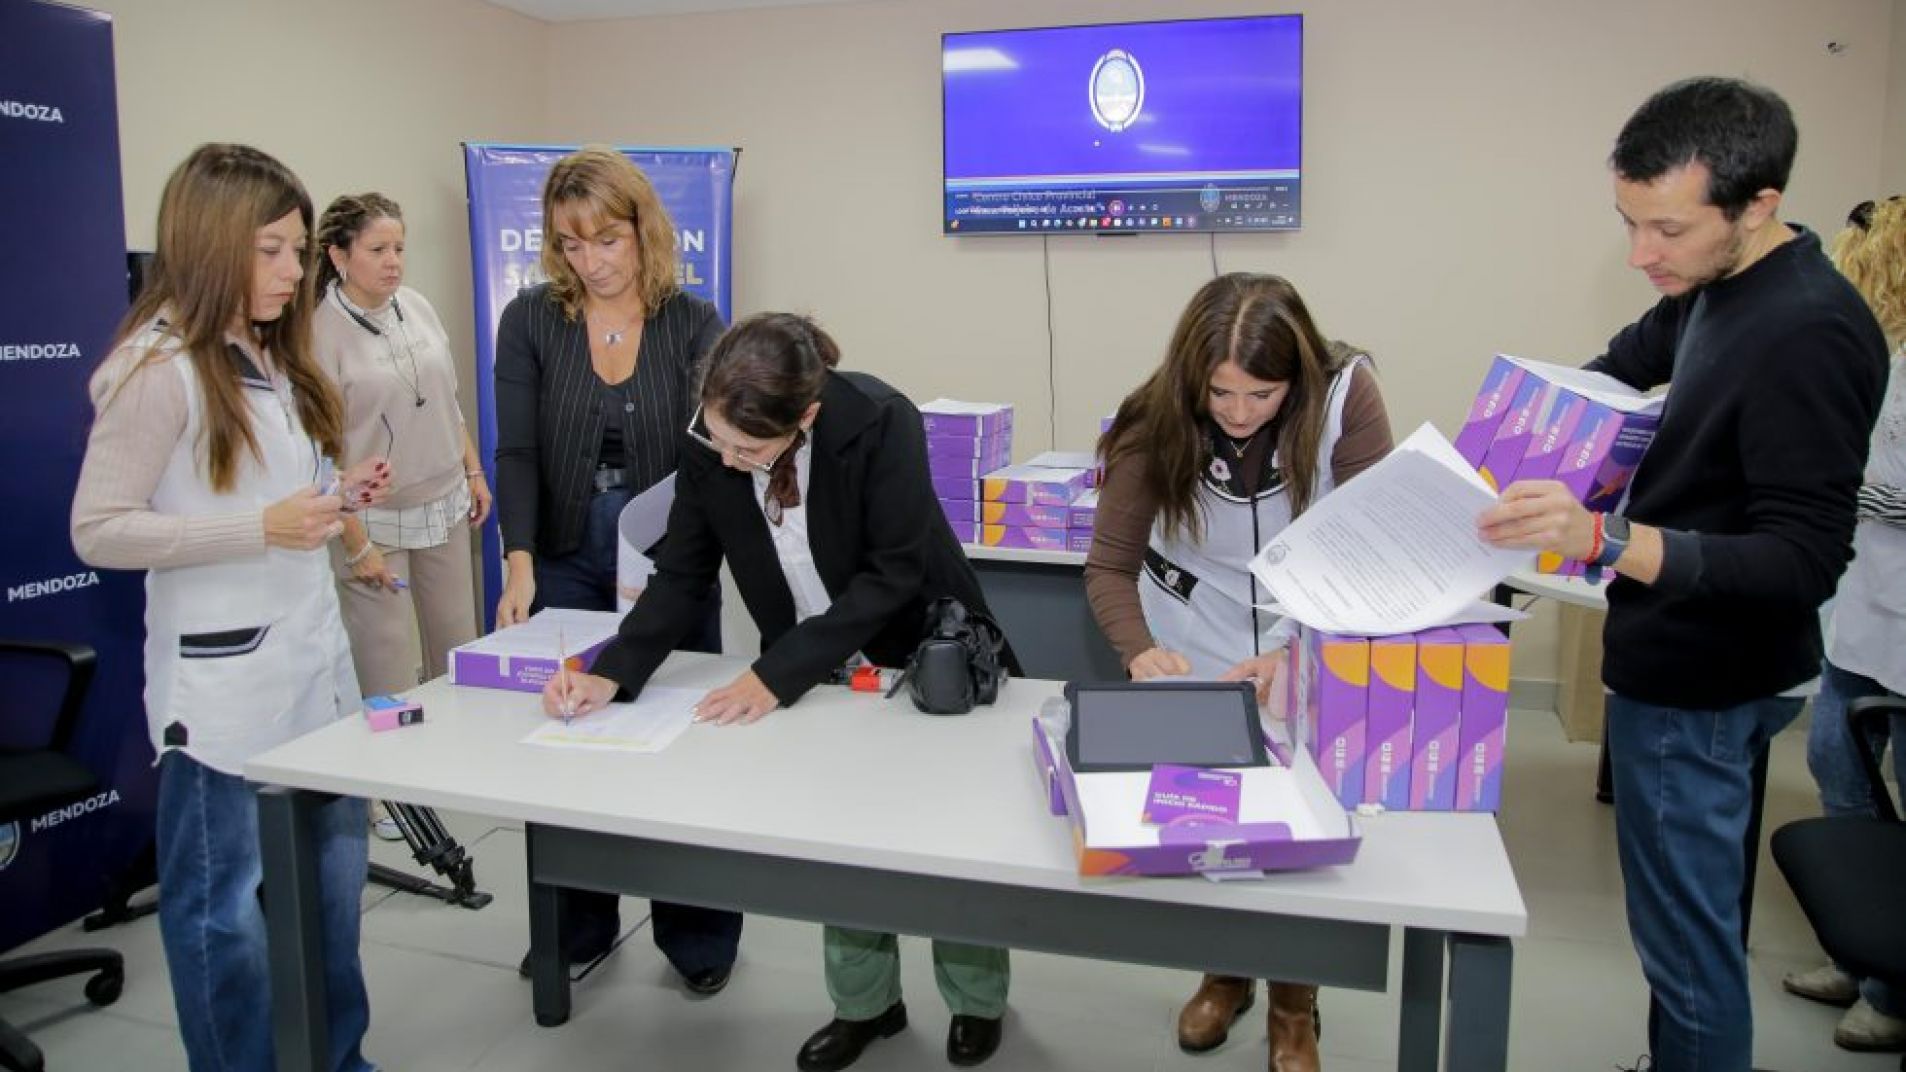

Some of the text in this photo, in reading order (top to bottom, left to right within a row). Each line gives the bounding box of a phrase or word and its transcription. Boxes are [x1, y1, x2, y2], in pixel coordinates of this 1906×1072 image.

[0, 98, 63, 123] NDOZA
[0, 343, 81, 361] ENDOZA
[7, 571, 99, 603] MENDOZA
[31, 789, 120, 833] MENDOZA
